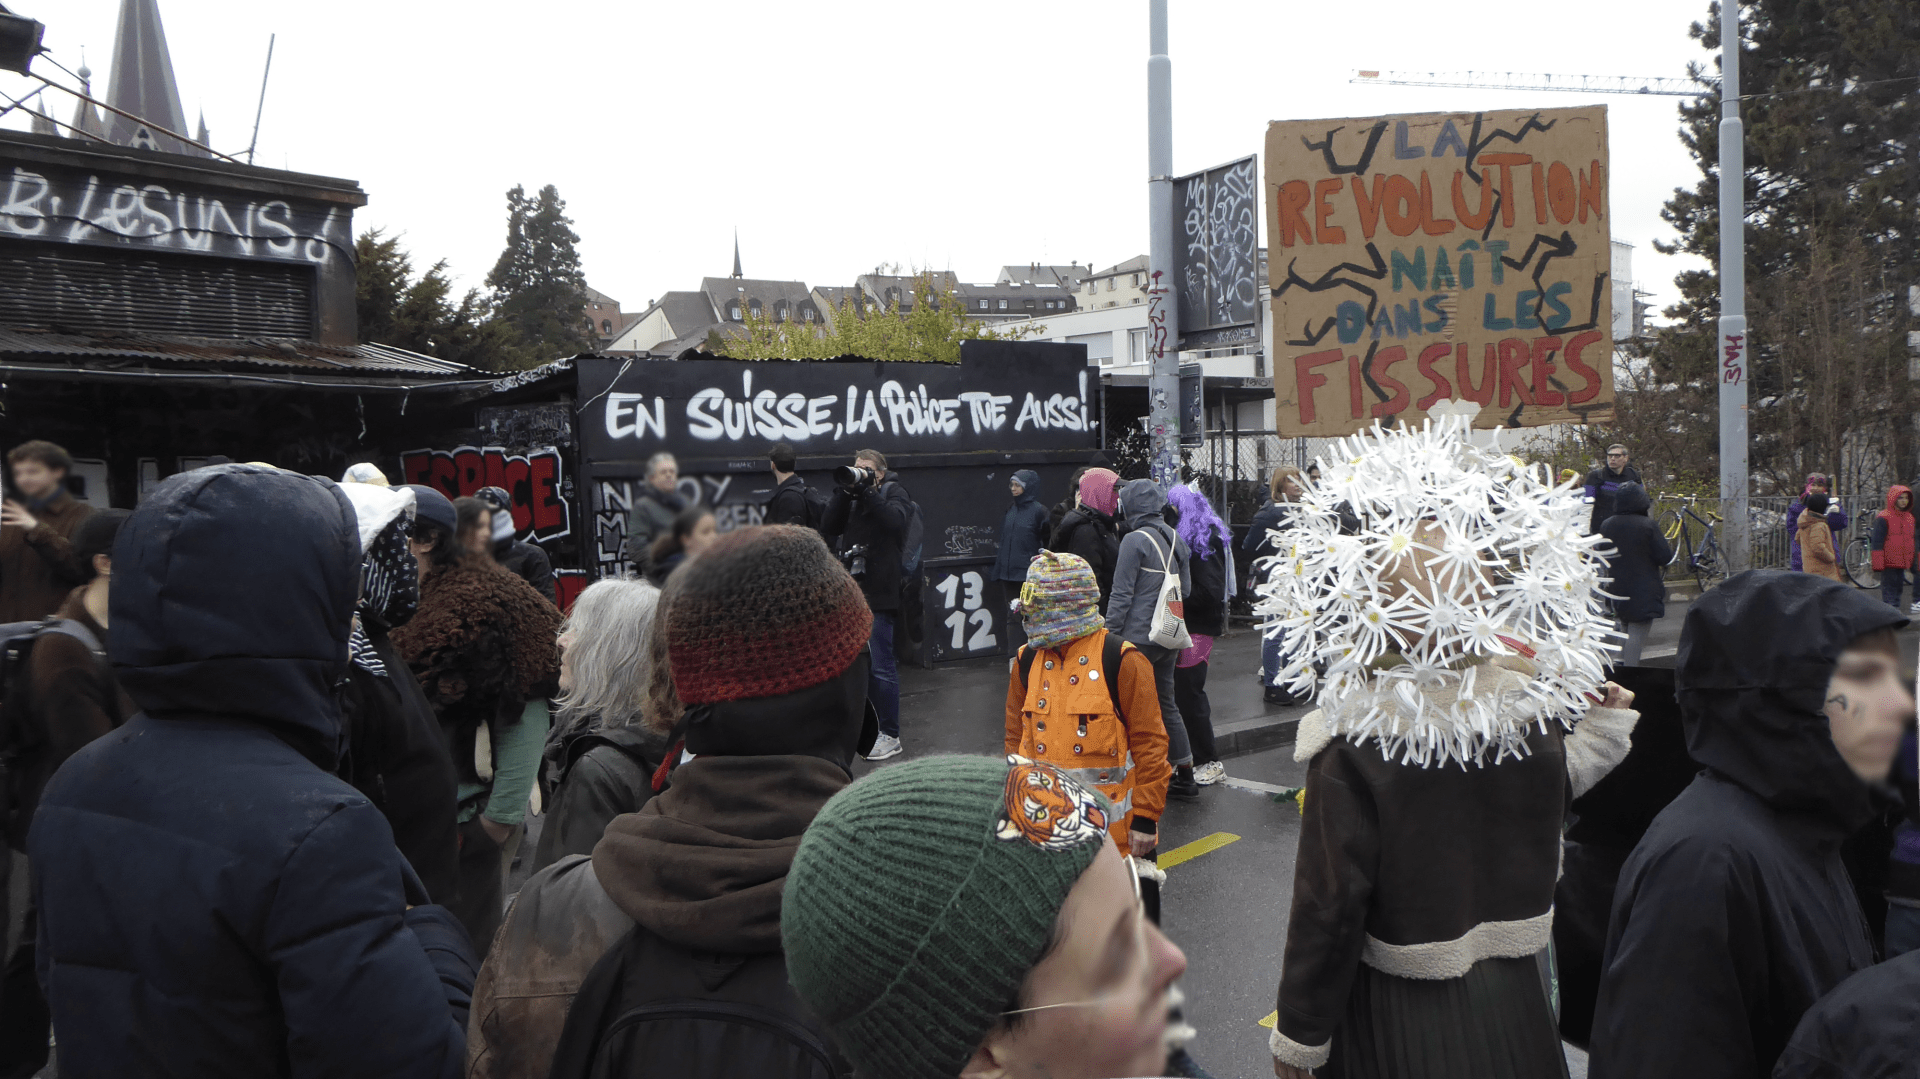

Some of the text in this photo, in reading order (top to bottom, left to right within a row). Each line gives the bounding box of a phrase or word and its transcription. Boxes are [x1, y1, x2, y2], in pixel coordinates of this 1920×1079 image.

[1394, 119, 1468, 160] LA
[1276, 152, 1602, 249] REVOLUTION
[1390, 239, 1510, 292] NAÎT
[1335, 281, 1573, 344] DANS LES
[1294, 330, 1604, 425] FISSURES
[605, 391, 667, 440] EN
[846, 384, 884, 435] LA
[960, 391, 1013, 435] TUE
[935, 571, 984, 610] 13
[944, 608, 997, 652] 12
